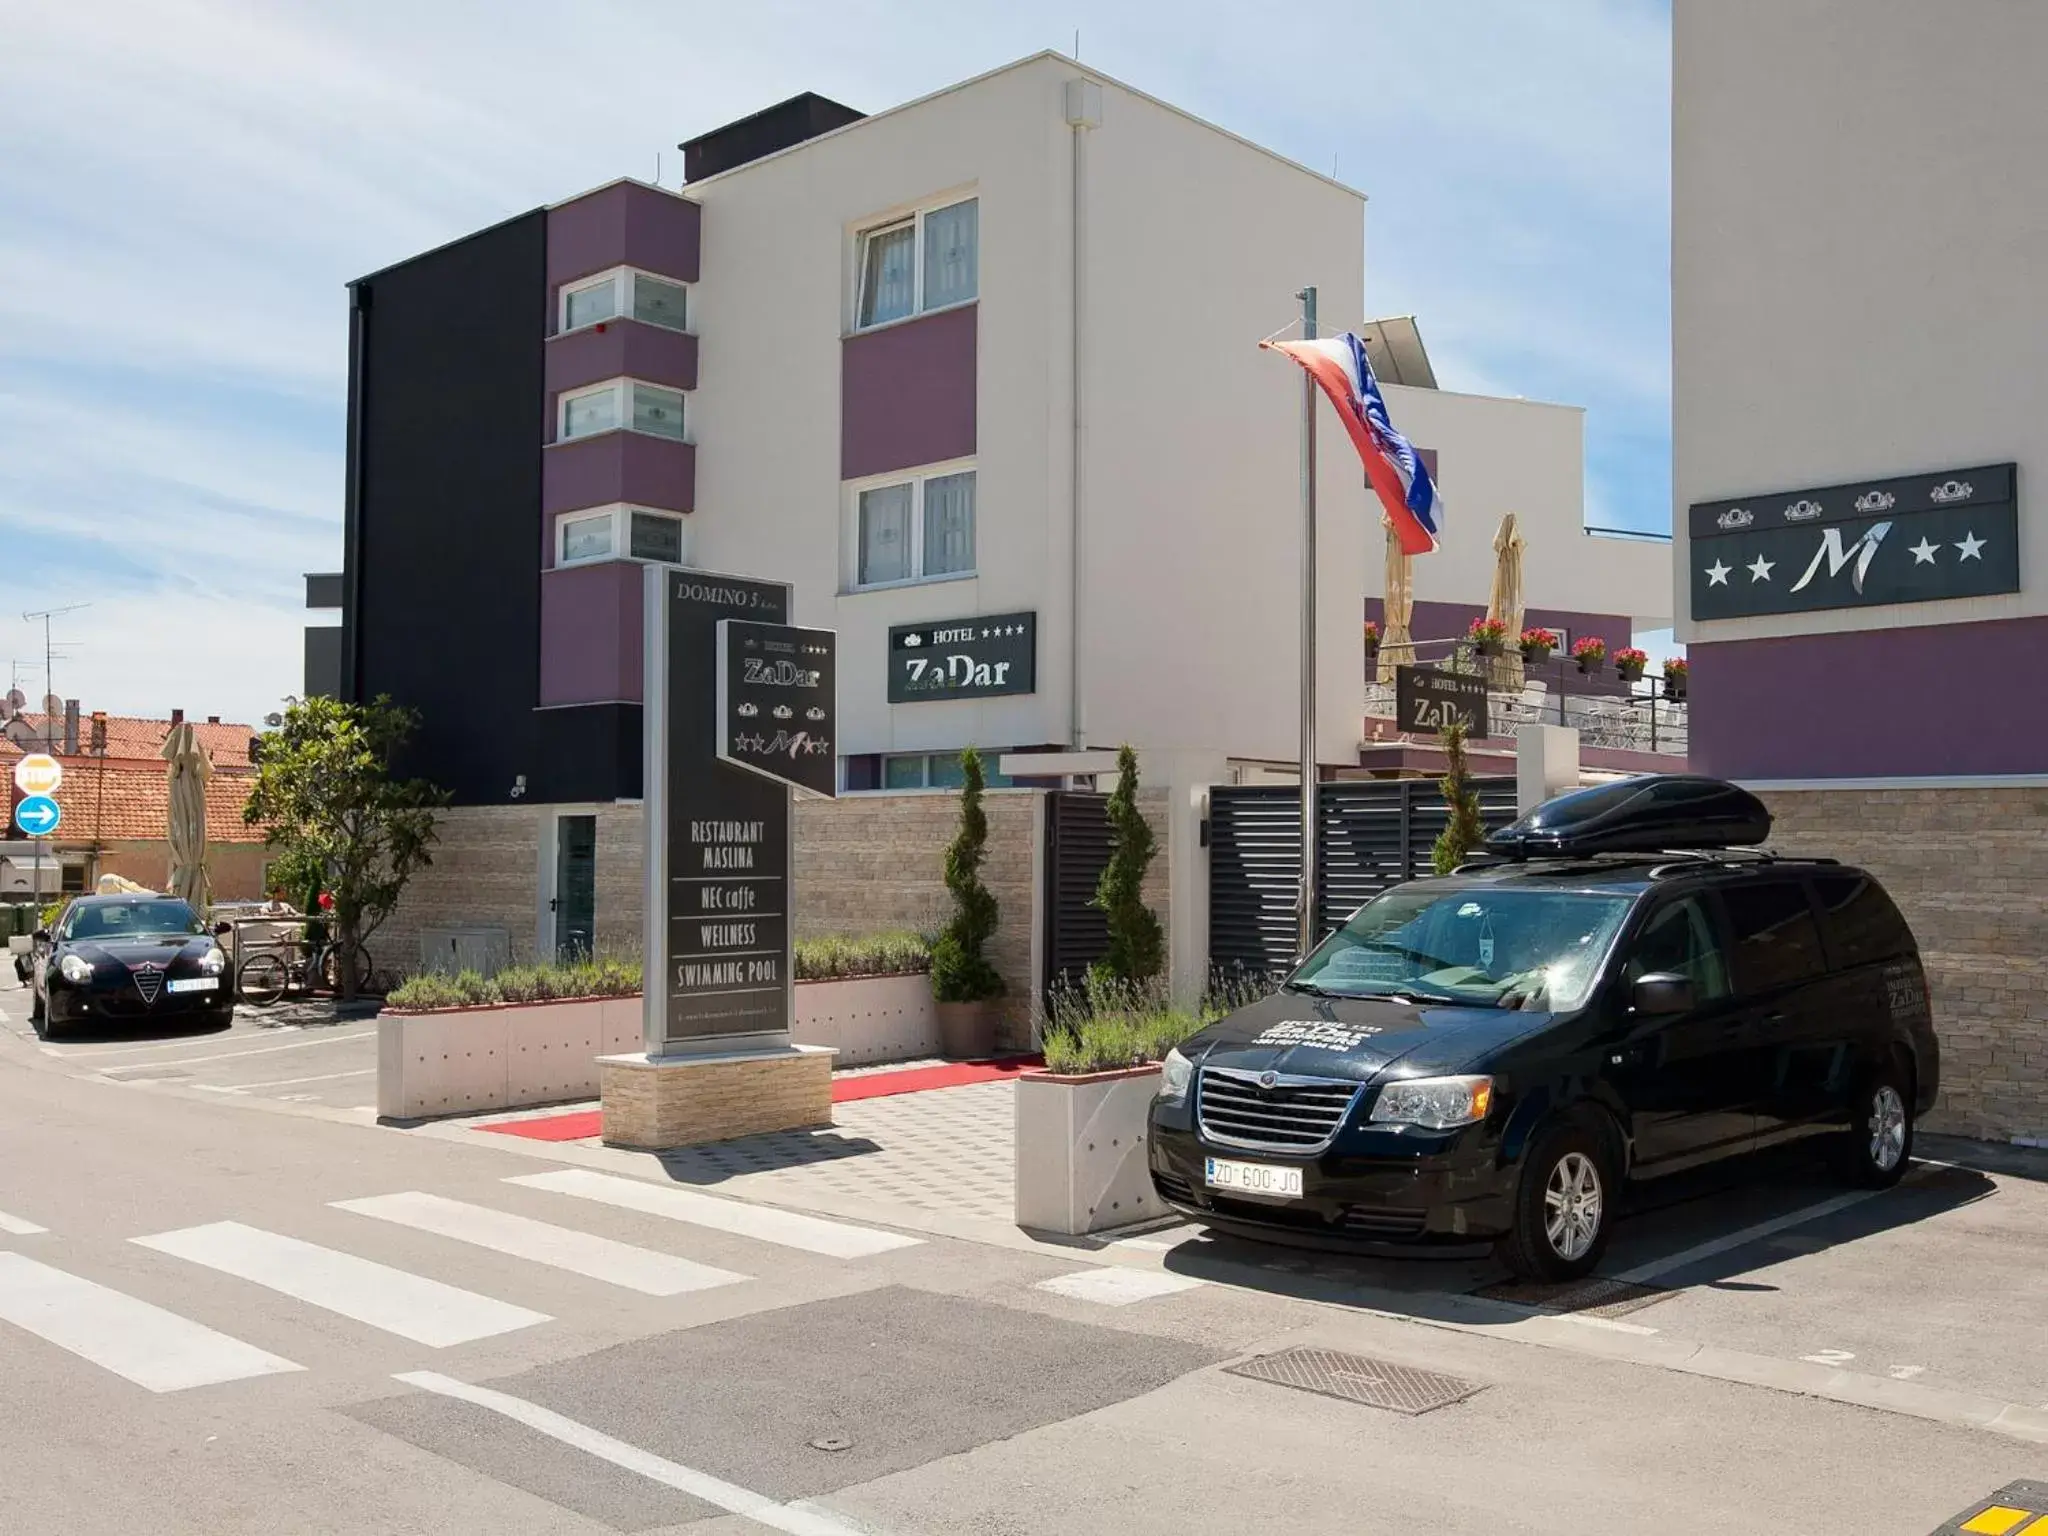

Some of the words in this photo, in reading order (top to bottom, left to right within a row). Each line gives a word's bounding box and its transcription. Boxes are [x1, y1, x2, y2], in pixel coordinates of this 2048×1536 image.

[677, 583, 747, 606] DOMINO
[933, 628, 975, 644] HOTEL
[744, 658, 821, 688] ZaDar
[905, 654, 1010, 691] ZaDar
[1431, 677, 1459, 692] HOTEL
[691, 820, 764, 844] RESTAURANT
[703, 846, 754, 869] MASLINA
[702, 886, 723, 909] NEC
[725, 886, 755, 910] caffe
[701, 922, 756, 948] WELLNESS
[677, 961, 743, 988] SWIMMING
[748, 959, 776, 983] POOL
[1216, 1163, 1232, 1184] ZD
[1243, 1167, 1271, 1189] 600
